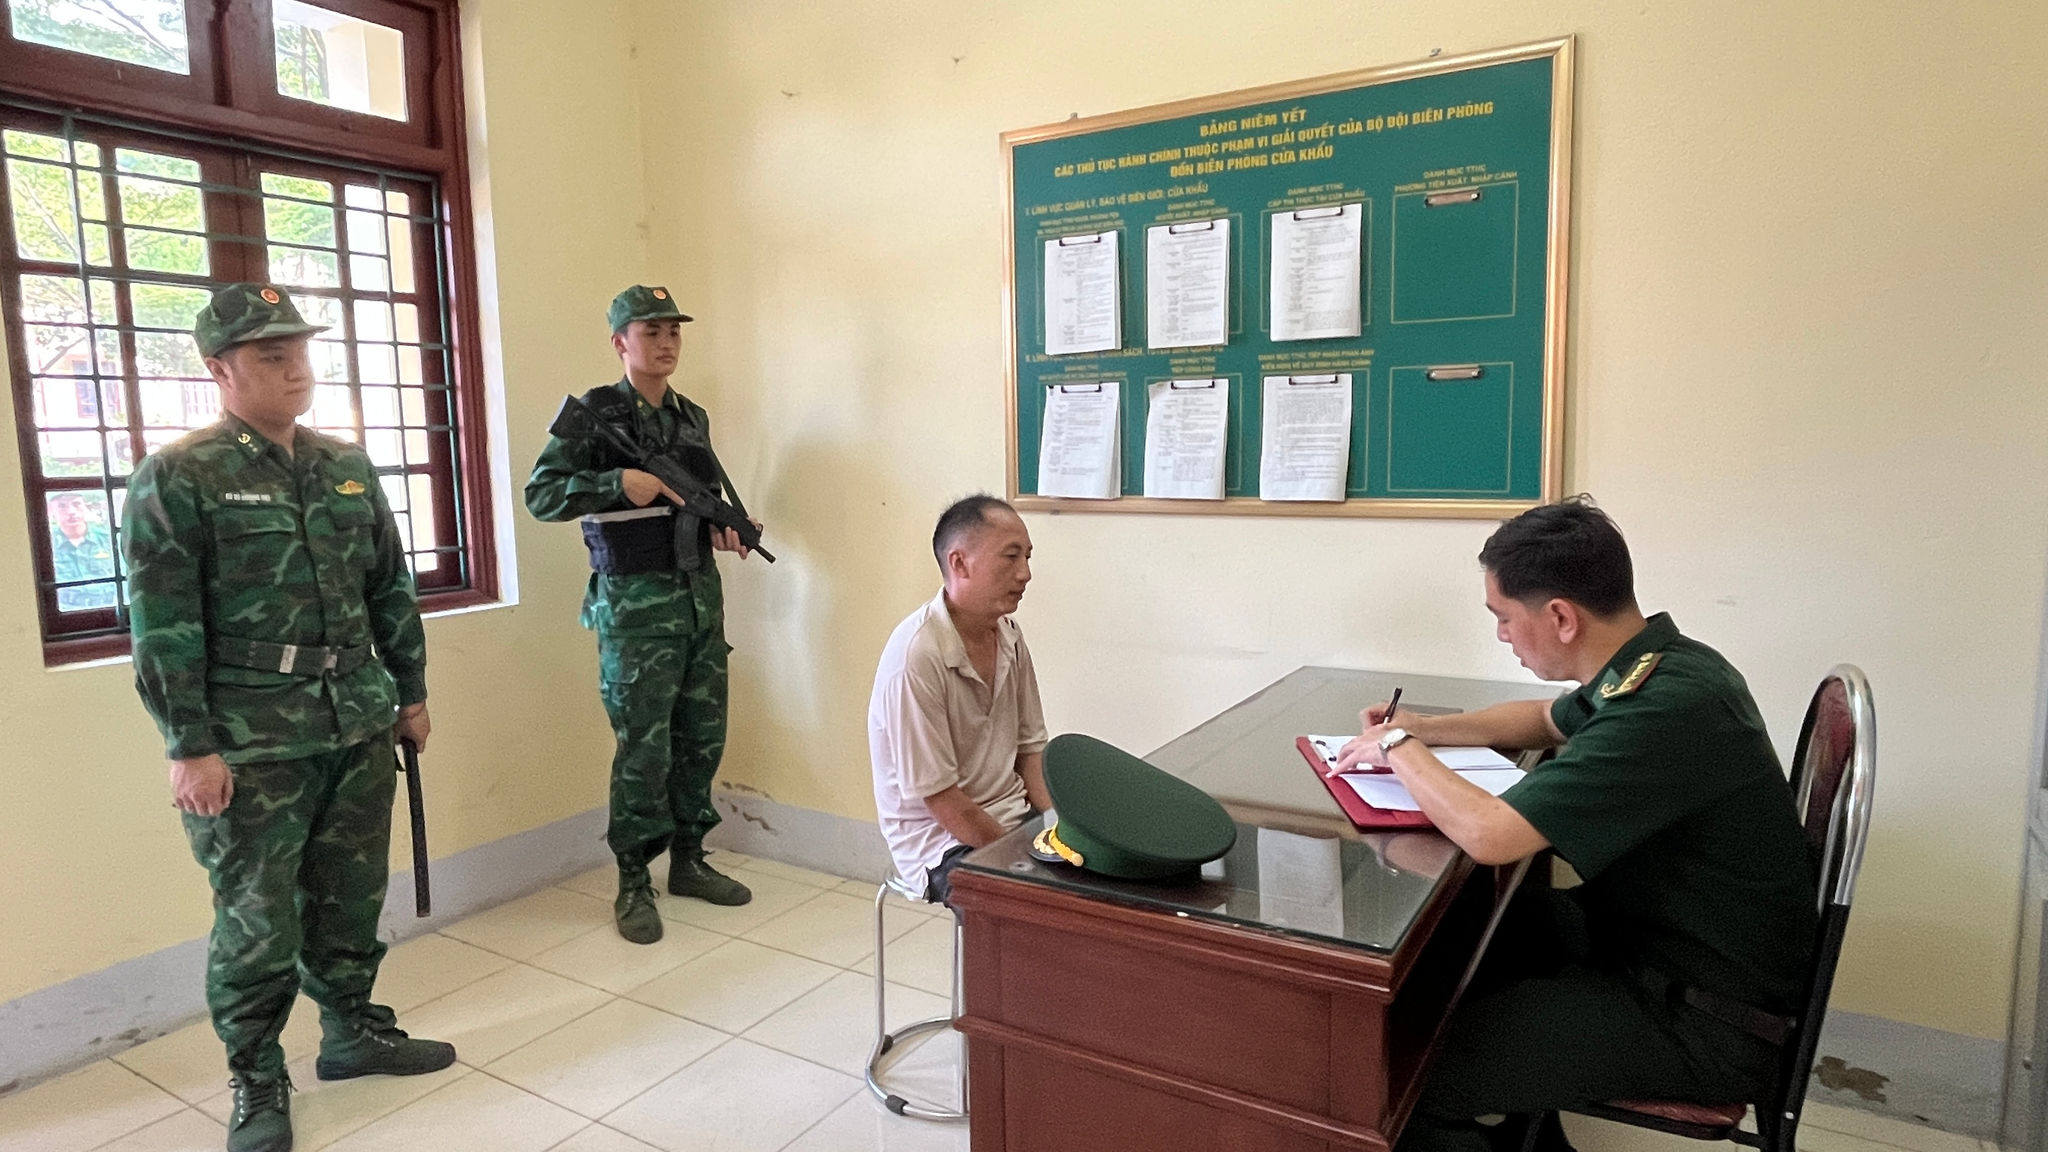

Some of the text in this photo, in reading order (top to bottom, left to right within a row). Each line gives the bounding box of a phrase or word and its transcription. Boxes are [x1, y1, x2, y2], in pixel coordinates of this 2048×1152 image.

[1200, 119, 1237, 137] BẢNG
[1282, 106, 1307, 123] YẾT
[1054, 163, 1074, 178] CÁC
[1098, 159, 1116, 173] TỤC
[1184, 142, 1219, 158] THUỘC
[1222, 137, 1254, 153] PHẠM
[1257, 135, 1268, 147] VI
[1298, 122, 1335, 142] QUYẾT
[1338, 118, 1363, 136] CỦA
[1366, 115, 1384, 133] BỘ
[1412, 107, 1443, 125] BIÊN
[1447, 100, 1494, 120] PHÒNG
[1197, 158, 1224, 175] BIÊN
[1227, 154, 1268, 170] PHÒNG
